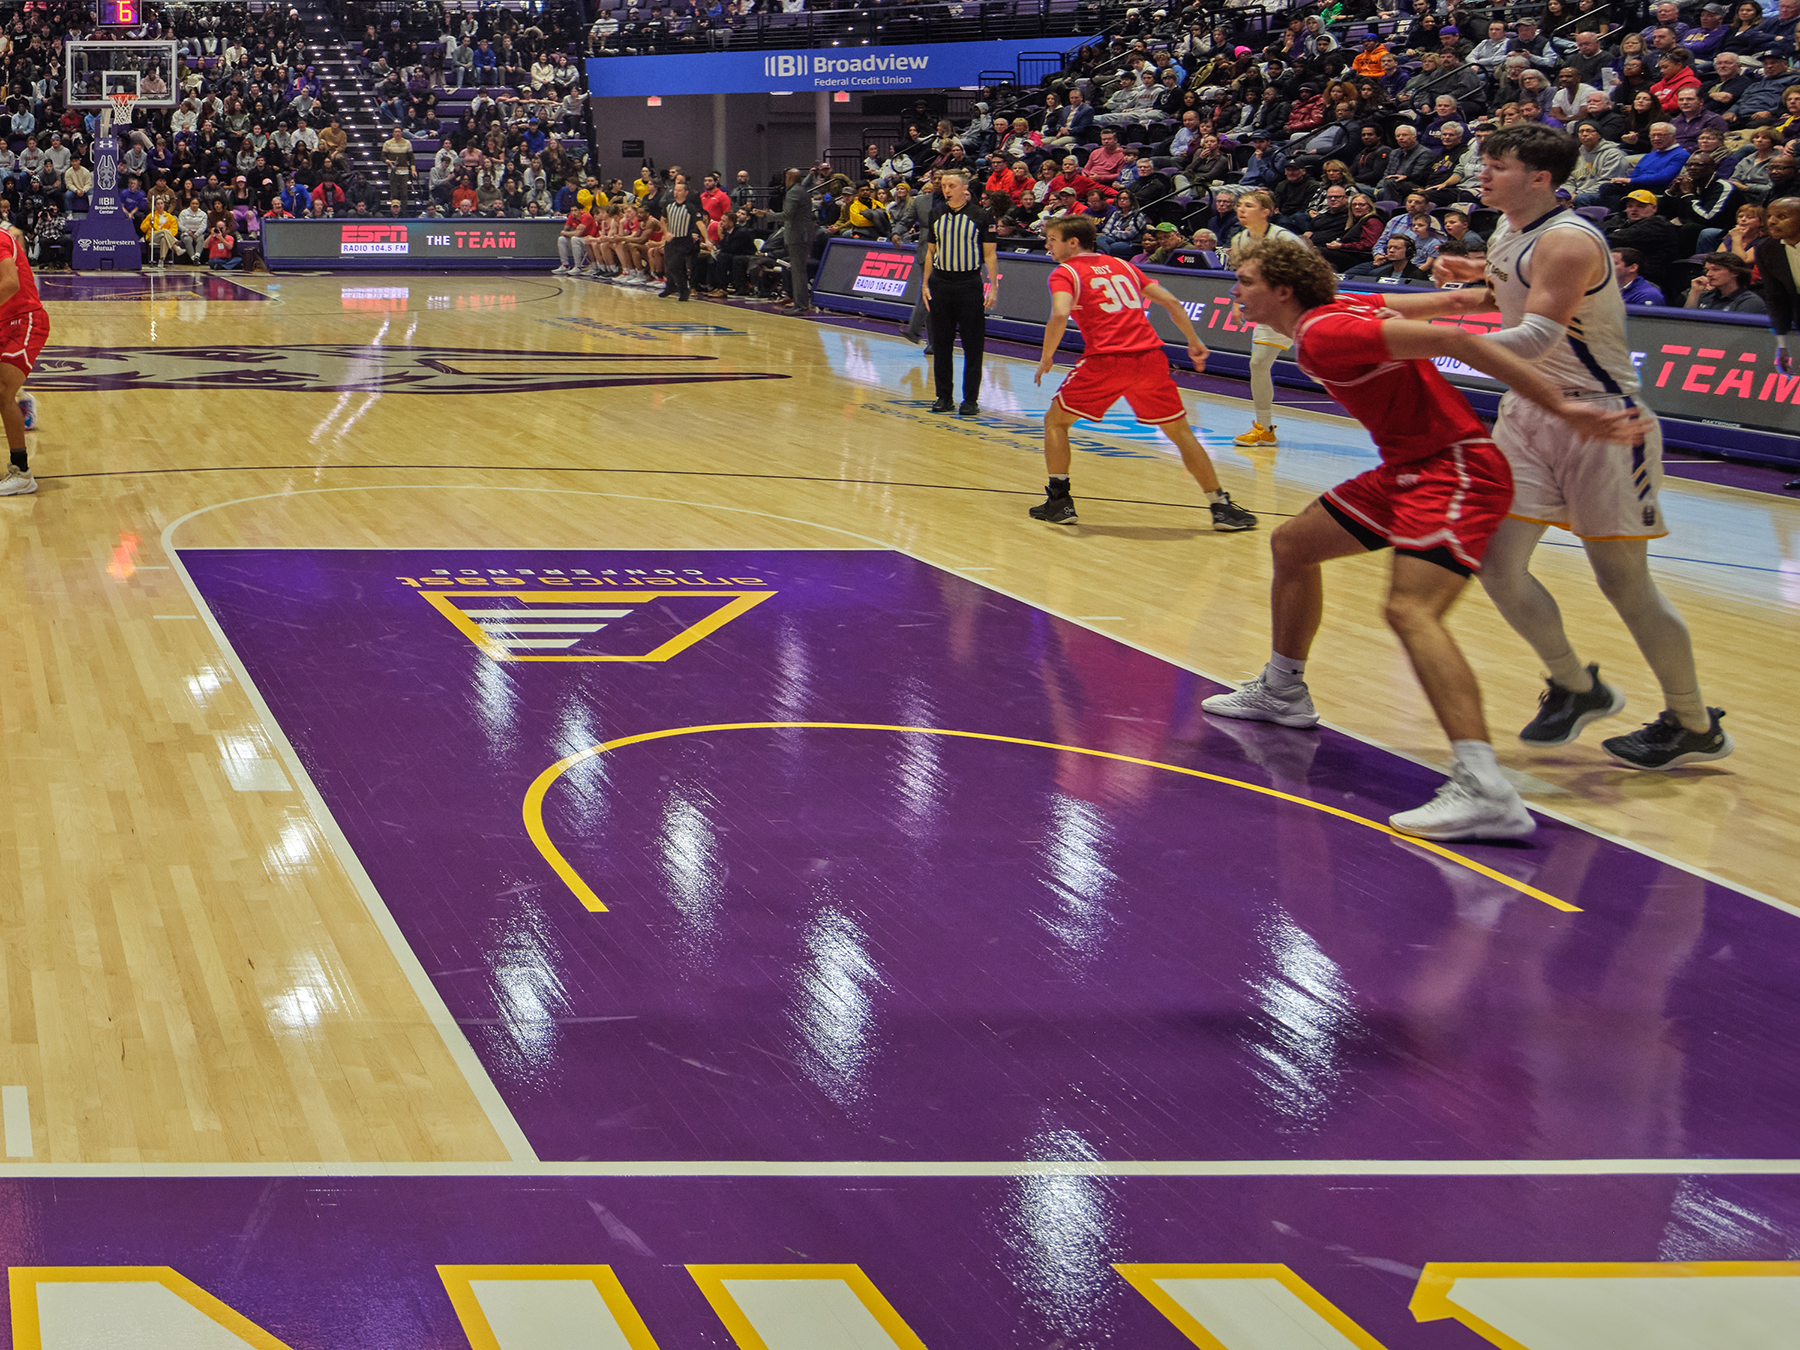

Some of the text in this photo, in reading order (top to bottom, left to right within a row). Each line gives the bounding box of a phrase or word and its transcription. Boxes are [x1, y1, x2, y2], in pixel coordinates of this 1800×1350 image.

[814, 53, 929, 73] Broadview
[814, 75, 912, 86] Federal Credit Union
[341, 225, 516, 248] ESPN THE TEAM
[859, 252, 915, 280] ESPN
[1090, 265, 1112, 275] ROY
[856, 278, 904, 293] RADIO 104.5 FM
[1090, 274, 1142, 313] 30
